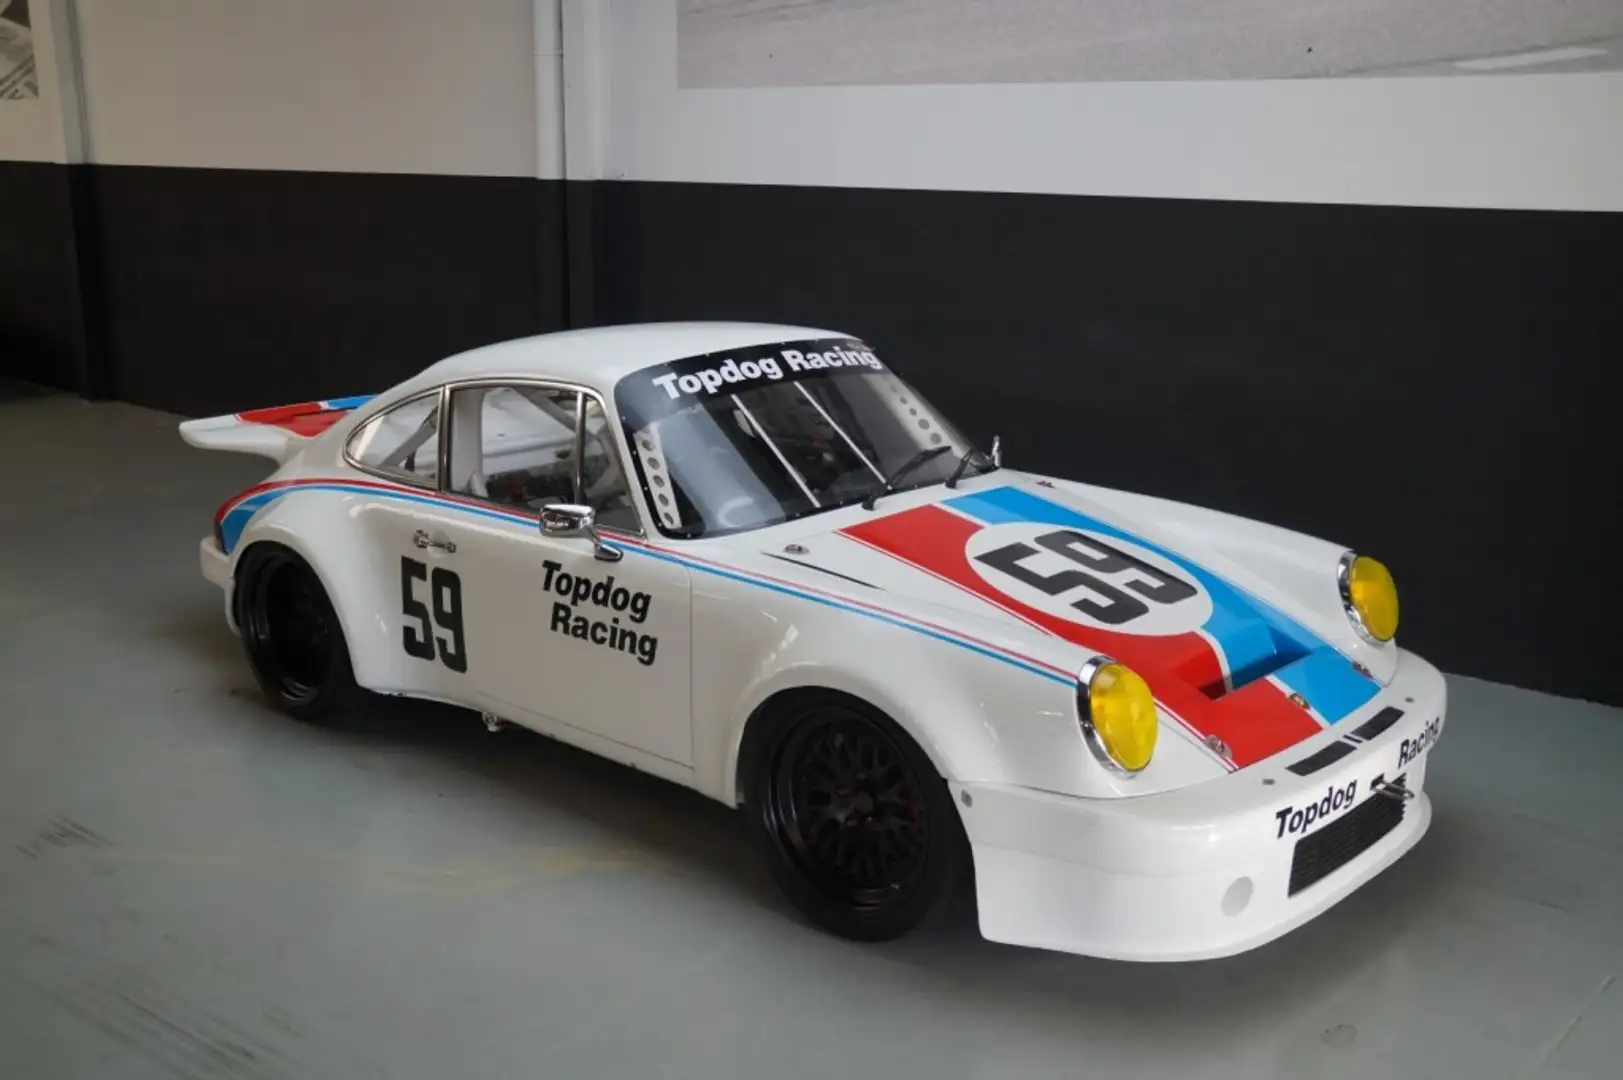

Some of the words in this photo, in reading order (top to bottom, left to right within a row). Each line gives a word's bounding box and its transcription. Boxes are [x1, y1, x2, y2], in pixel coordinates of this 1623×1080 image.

[652, 357, 784, 399] Topdog
[781, 346, 883, 371] Racing
[541, 560, 652, 624] Topdog
[974, 530, 1198, 624] 59
[401, 555, 467, 673] 59
[551, 601, 658, 666] Racing
[1276, 779, 1357, 839] Topdog
